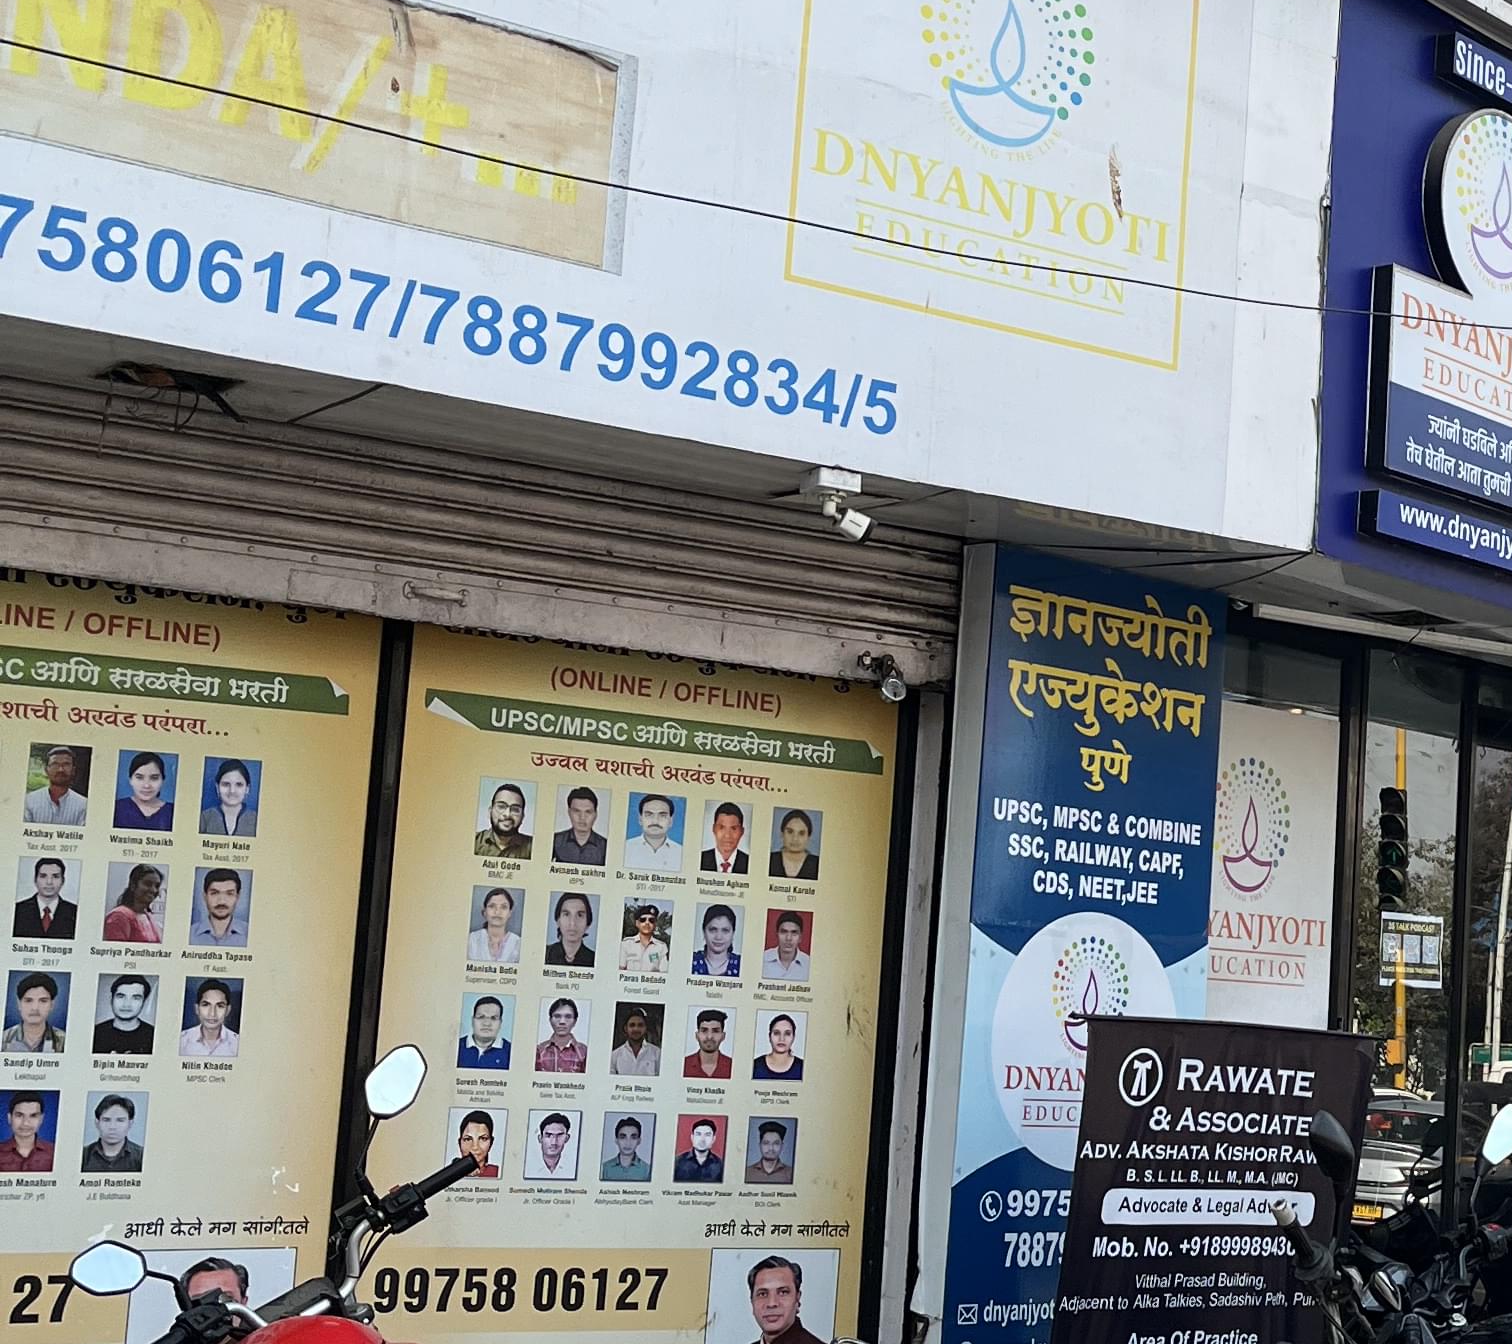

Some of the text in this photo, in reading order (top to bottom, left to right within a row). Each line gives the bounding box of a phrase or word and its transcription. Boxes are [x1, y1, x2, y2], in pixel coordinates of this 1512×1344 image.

[811, 128, 1172, 263] DNYANJYOTI
[855, 212, 1126, 305] EDUCATION
[1428, 415, 1460, 444] ज्यांनी
[1462, 427, 1498, 458] घडविले
[1406, 436, 1424, 466] तेच
[1424, 444, 1456, 477] घेतील
[1457, 460, 1483, 487] आता
[1482, 469, 1512, 497] तुमची
[83, 610, 222, 653] OFFLINE)
[1008, 585, 1212, 669] ज्ञानज्योती
[31, 658, 290, 705] आणि सरळसेवा भरती
[550, 665, 652, 699] (ONLINE
[673, 681, 783, 719] OFFLINE)
[1007, 658, 1206, 739] एज्युकेशन
[490, 707, 837, 765] UPSC/MPSC आणि सरळसेवा भरती
[1080, 740, 1133, 793] पुणे
[993, 797, 1202, 846] UPSC, MPSC COMBINE
[1008, 833, 1185, 881] SSC, RAILWAY, CAPF,
[1032, 870, 1073, 900] CDS,
[1177, 1058, 1316, 1099] RAWATE
[1126, 1140, 1278, 1163] AKSHATA KISHOR
[124, 1217, 163, 1239] आधी
[170, 1216, 202, 1237] केले
[208, 1220, 236, 1236] मग
[704, 1219, 736, 1238] आधी
[740, 1218, 767, 1237] केले
[770, 1224, 792, 1237] मग
[1118, 1196, 1244, 1217] Advocate Legal
[1093, 1236, 1173, 1258] Mob. No.
[373, 1267, 669, 1314] 99758 06127
[1059, 1292, 1262, 1315] Adjacent to Alka Sadashiv
[1135, 1272, 1267, 1290] Vitthal Prasad Building,
